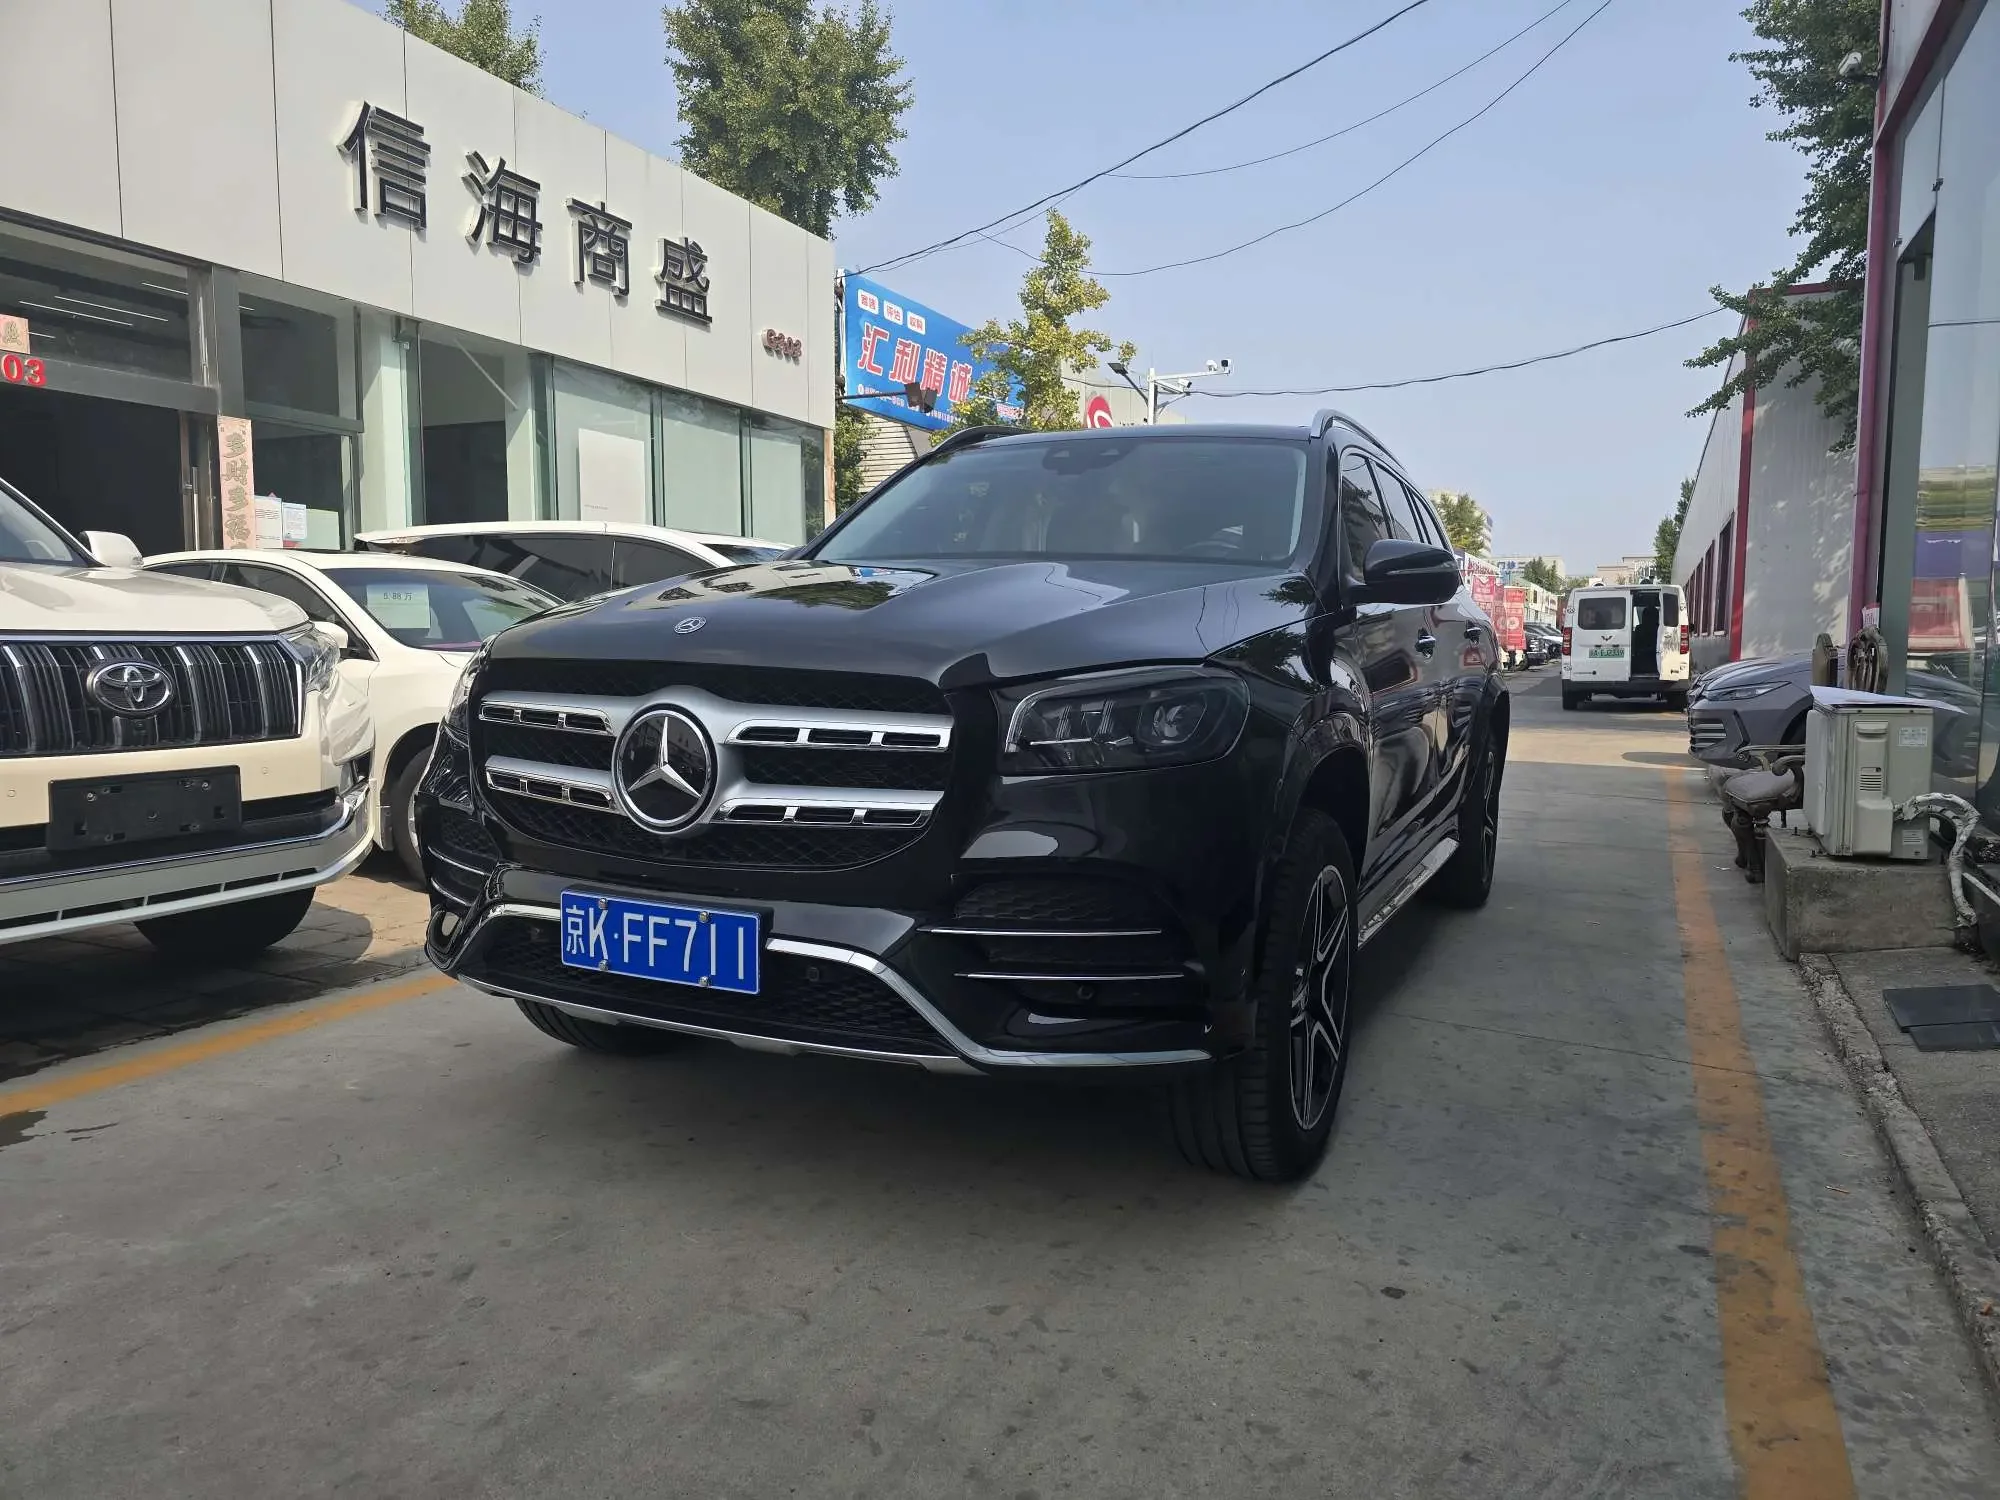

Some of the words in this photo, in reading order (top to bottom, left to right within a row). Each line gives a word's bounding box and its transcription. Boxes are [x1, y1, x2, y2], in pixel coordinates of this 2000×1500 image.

[337, 101, 712, 324] 信海商盛
[1, 354, 47, 387] 03
[858, 321, 972, 403] 汇利精诚
[565, 904, 745, 980] 京K·FF711
